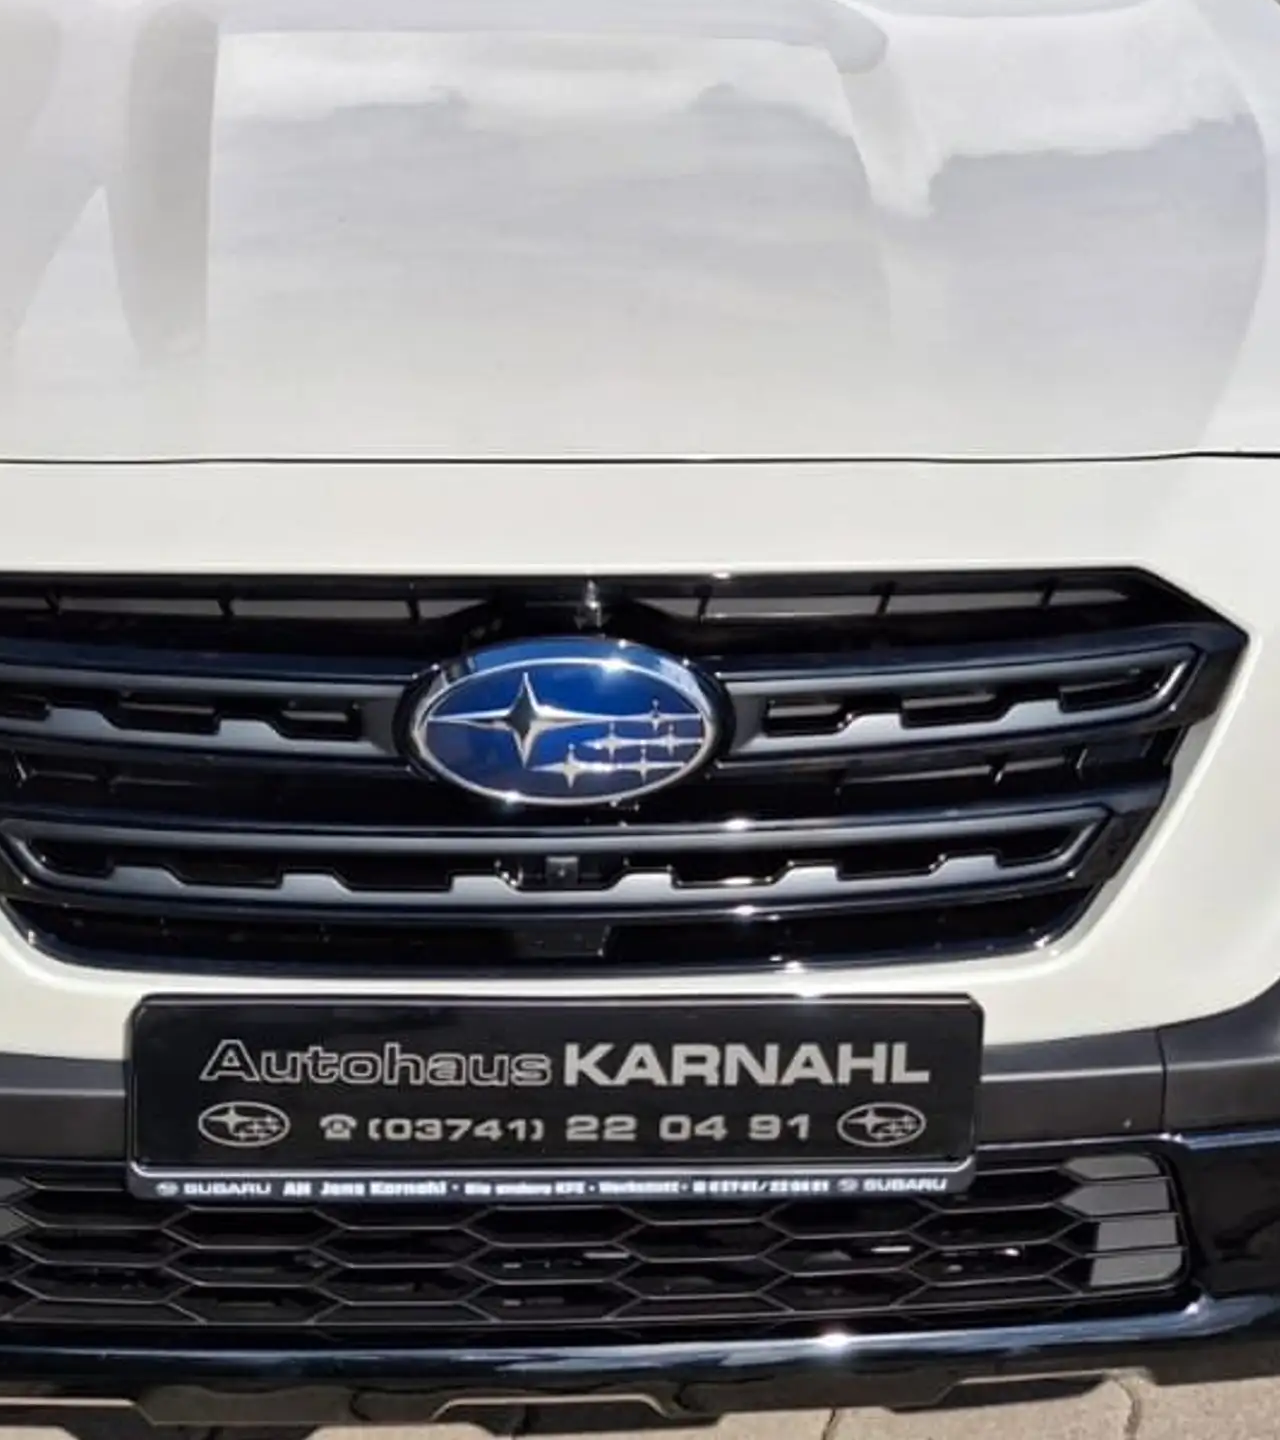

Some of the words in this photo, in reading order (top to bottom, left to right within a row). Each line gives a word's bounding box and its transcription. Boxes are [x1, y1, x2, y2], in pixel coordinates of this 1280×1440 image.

[200, 1039, 552, 1086] Autohaus
[563, 1042, 930, 1087] KARNAHL
[368, 1118, 545, 1141] (03741)
[566, 1115, 638, 1141] 22
[659, 1114, 729, 1141] 04
[748, 1114, 810, 1141] 91
[183, 1182, 272, 1196] SUBARU
[863, 1178, 947, 1192] SUBARU
